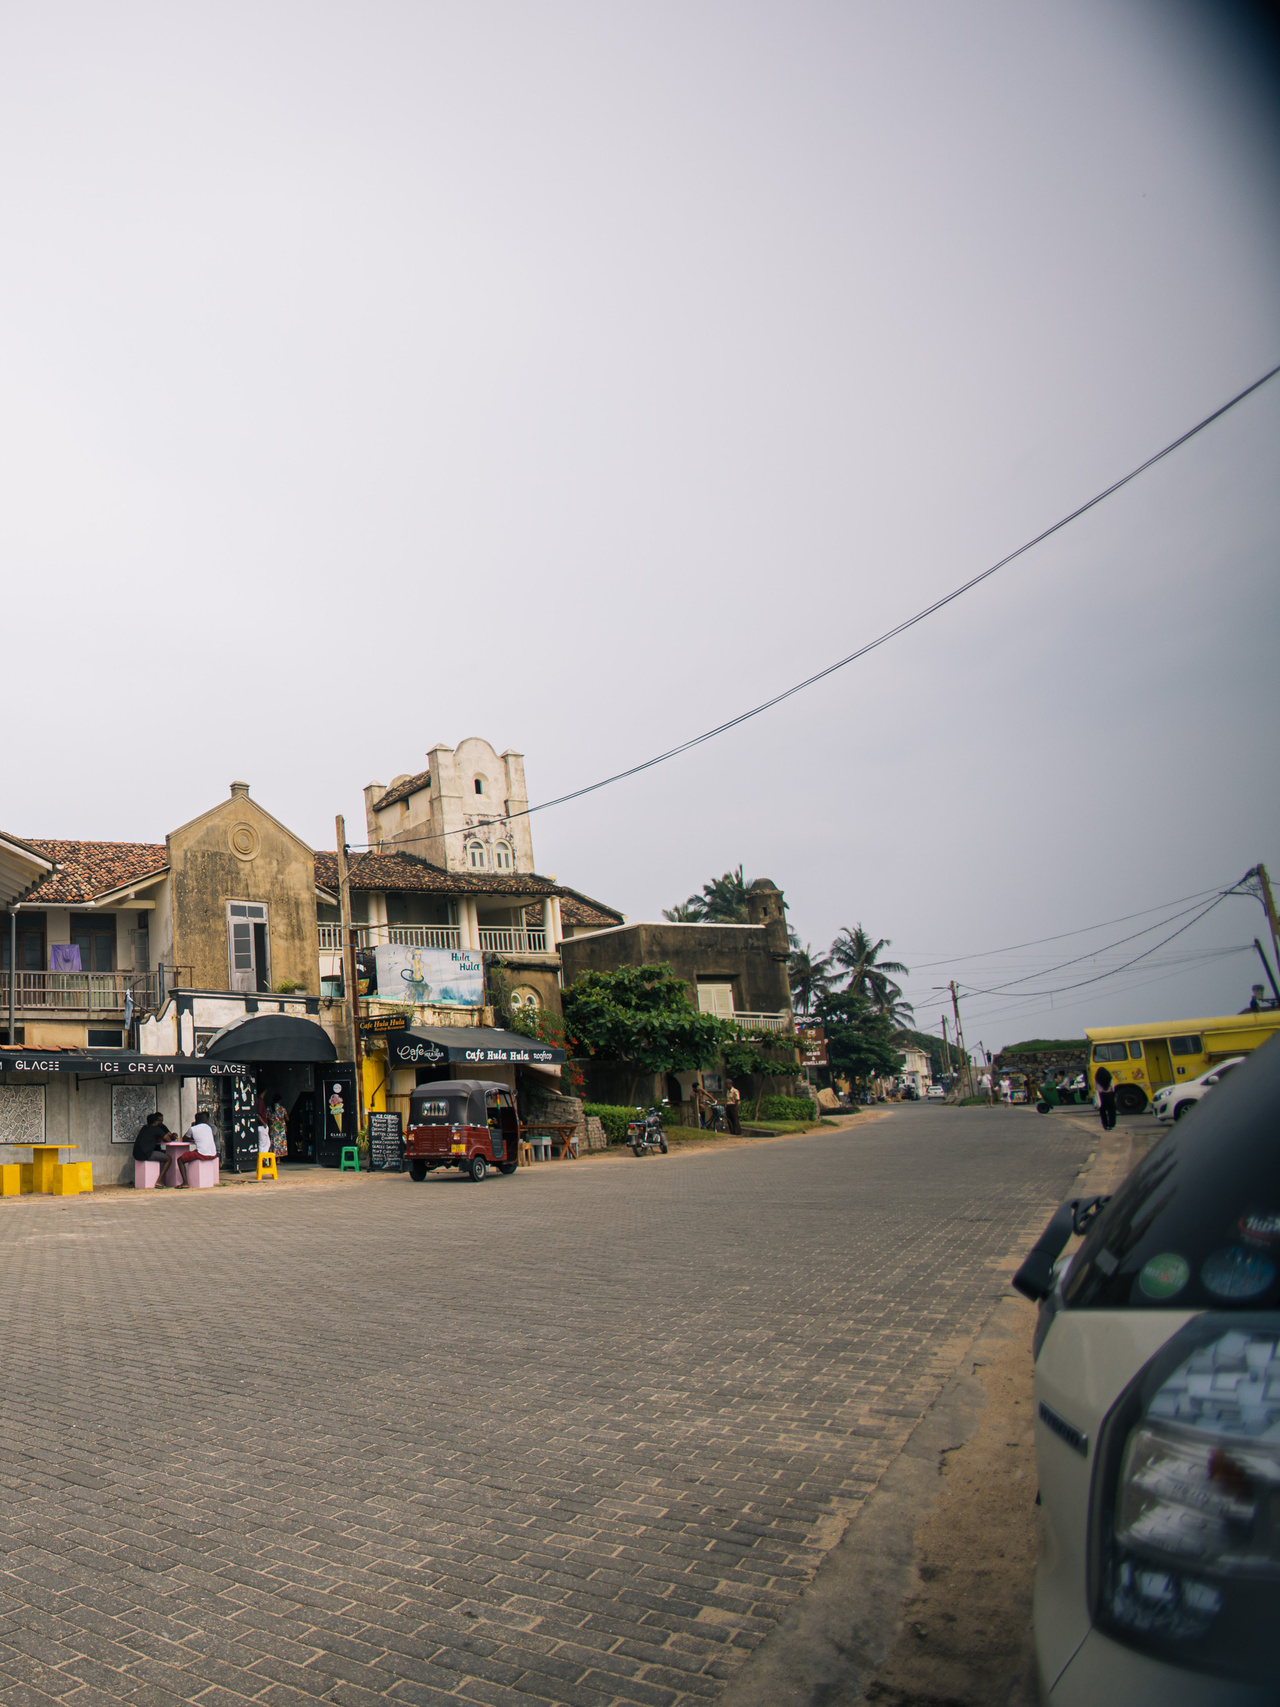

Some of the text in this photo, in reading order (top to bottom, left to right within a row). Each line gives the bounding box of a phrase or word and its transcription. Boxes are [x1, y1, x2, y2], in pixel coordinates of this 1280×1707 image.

[451, 952, 470, 961] Hula
[459, 962, 480, 971] Hula
[359, 1018, 405, 1030] Cafe Hula Hula
[396, 1043, 424, 1062] Cafe
[465, 1048, 484, 1061] Cafe
[487, 1049, 507, 1060] Hula
[510, 1050, 529, 1060] Hula
[15, 1060, 246, 1074] GLACEE ICE CREAM GLACEE
